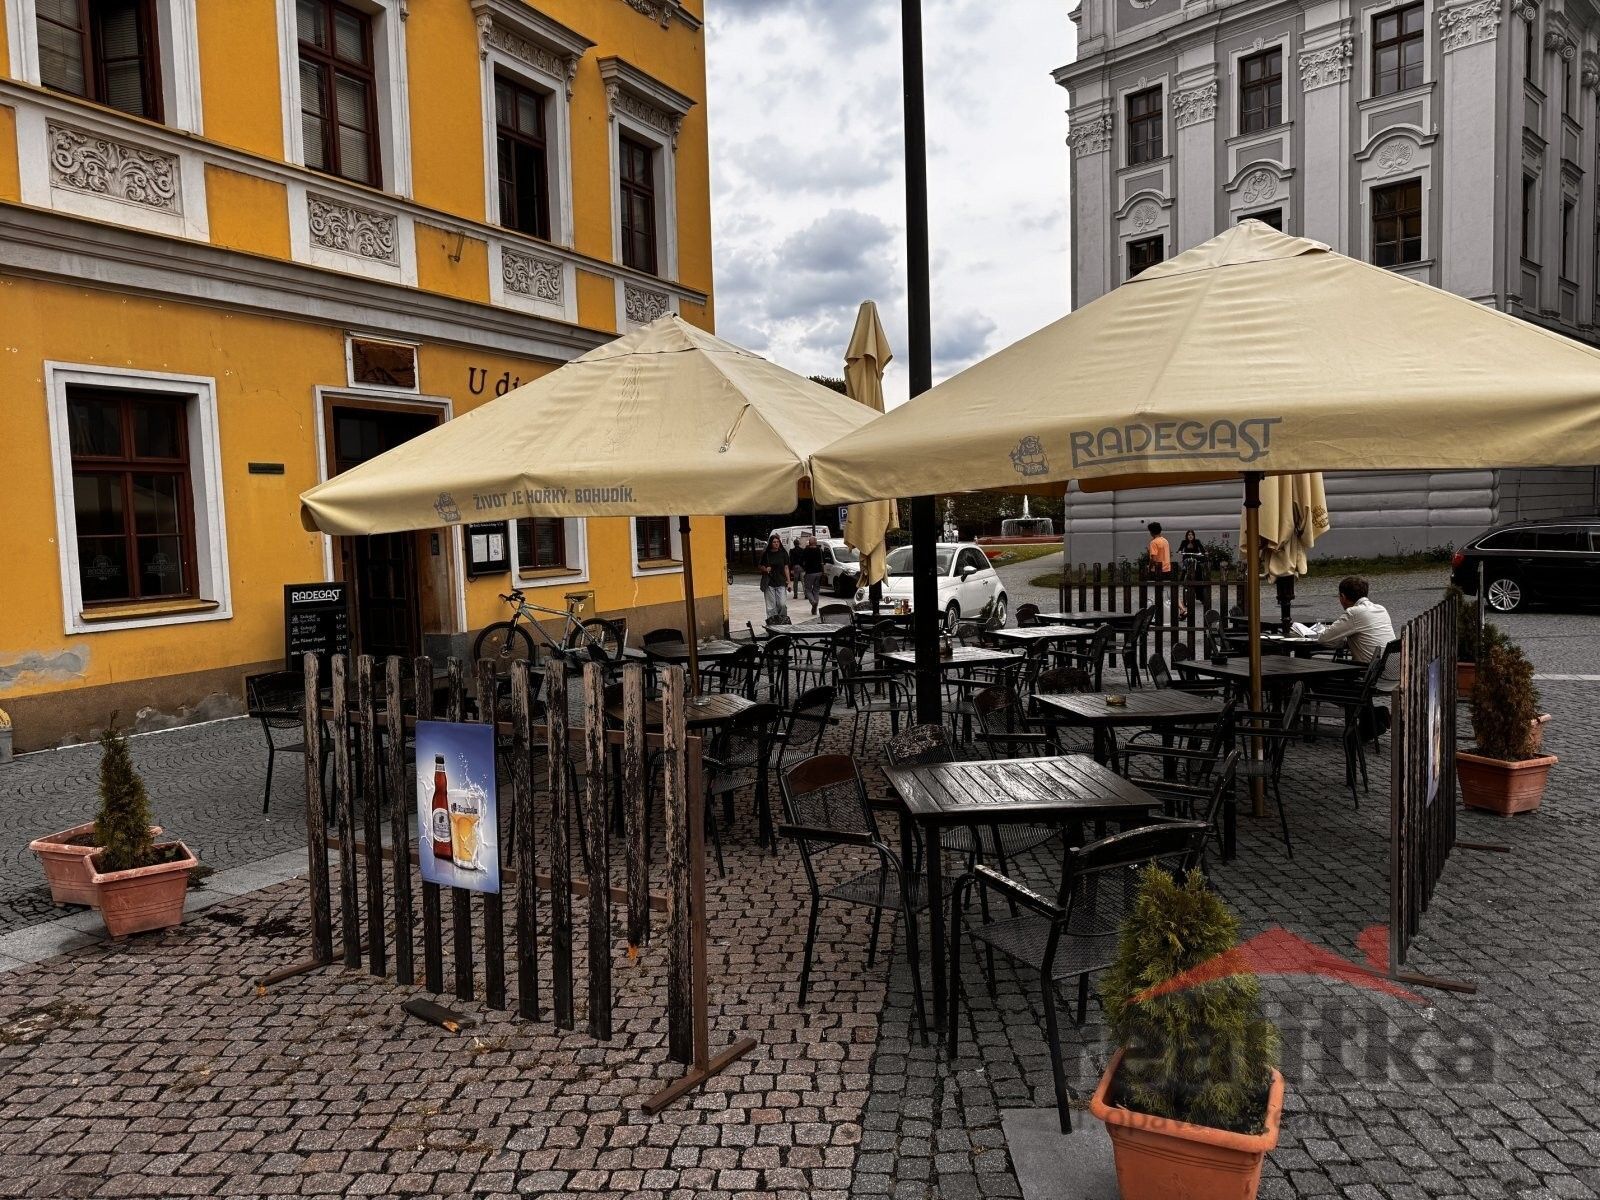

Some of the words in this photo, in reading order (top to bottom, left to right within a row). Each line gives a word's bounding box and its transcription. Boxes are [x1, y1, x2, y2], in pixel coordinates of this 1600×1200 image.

[469, 366, 487, 395] U
[1069, 416, 1283, 469] RADEGAST
[472, 492, 508, 511] ŽIVOT
[511, 490, 524, 506] JE
[526, 485, 571, 504] HOŘKÝ.
[575, 484, 637, 503] BOHUDÍK.
[292, 589, 341, 603] RADEGAST
